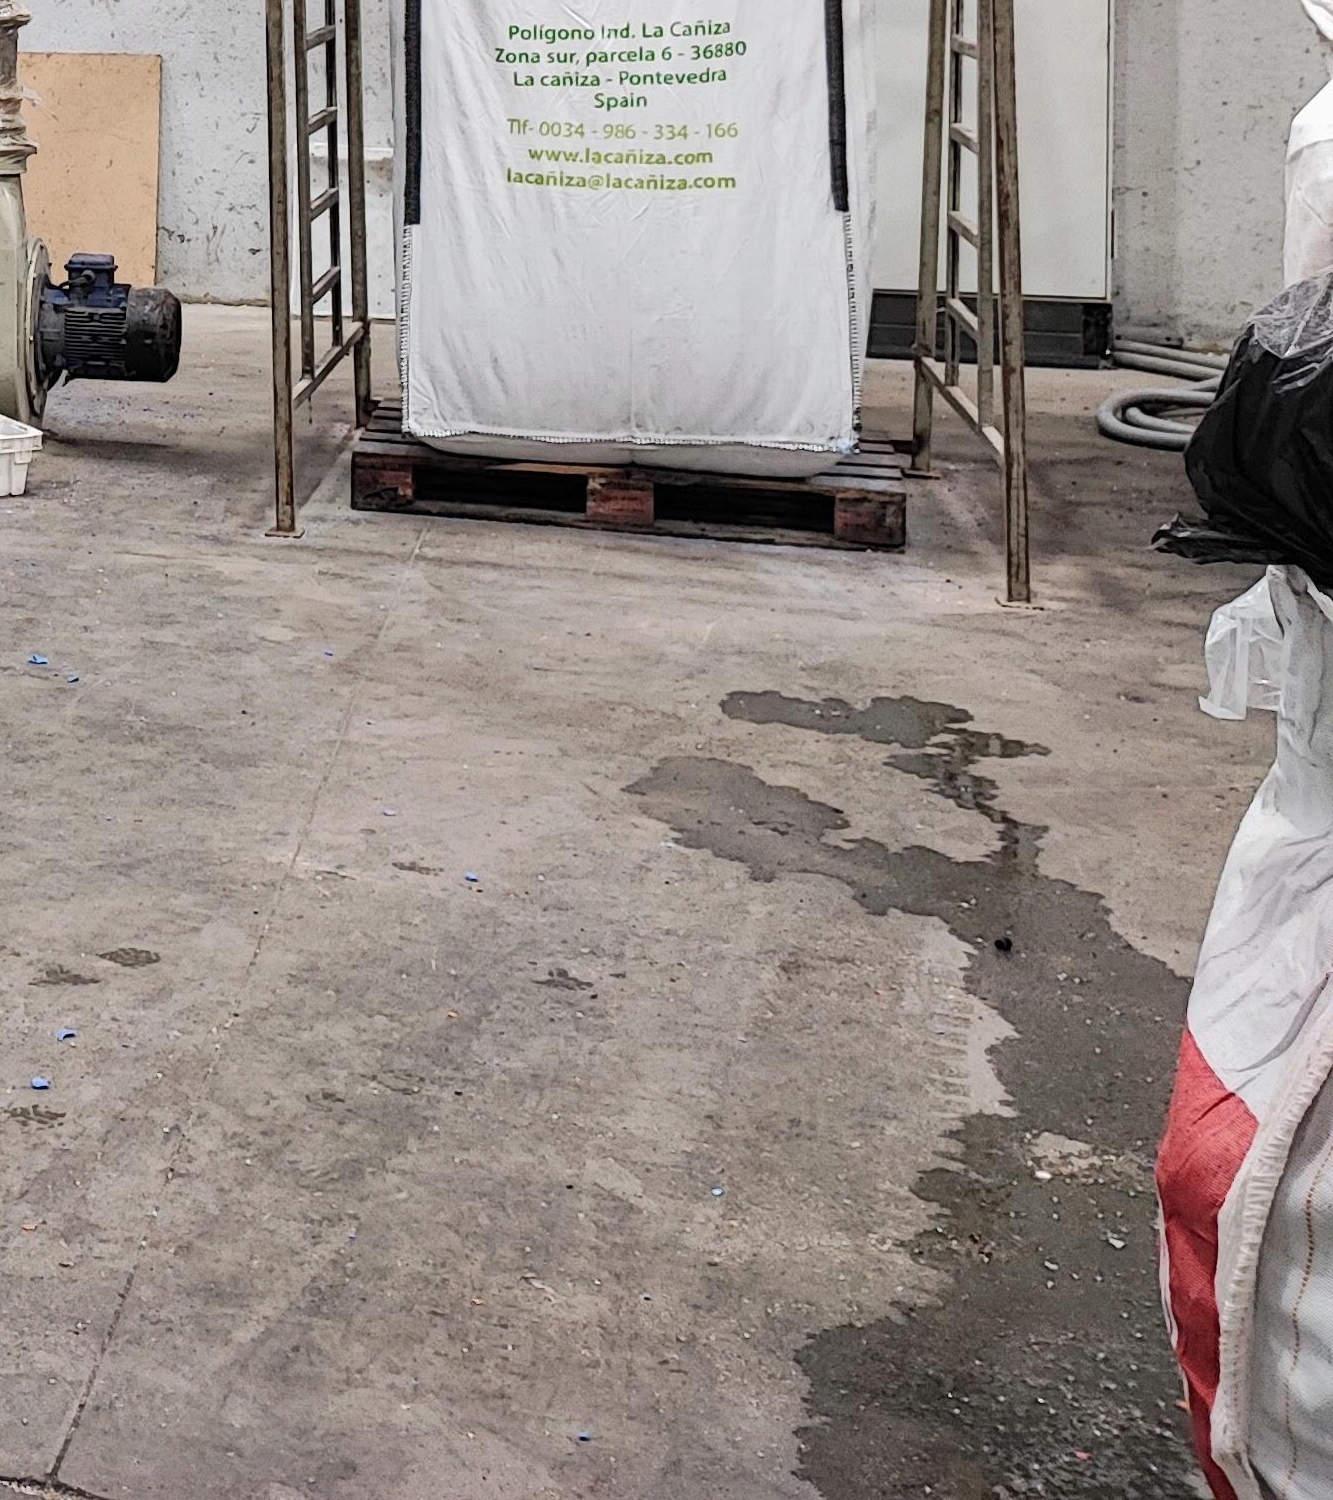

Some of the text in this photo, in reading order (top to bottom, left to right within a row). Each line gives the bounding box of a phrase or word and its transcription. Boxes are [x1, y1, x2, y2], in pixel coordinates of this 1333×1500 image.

[508, 20, 731, 44] Polígono Ind. La Cañiza
[494, 47, 541, 64] Zona
[546, 51, 581, 66] sur,
[585, 46, 655, 67] parcela
[661, 46, 672, 61] 6
[690, 40, 747, 61] 36880
[513, 71, 535, 87] La
[539, 71, 601, 88] cañiza
[619, 67, 727, 86] Pontevedra
[593, 92, 648, 112] Spain
[538, 120, 585, 138] 0034
[603, 123, 637, 140] 986
[653, 124, 688, 140] 334
[706, 122, 739, 139] 166
[527, 147, 713, 166] www.lacañiza.com
[507, 167, 736, 191] lacañiza@lacañiza.com
